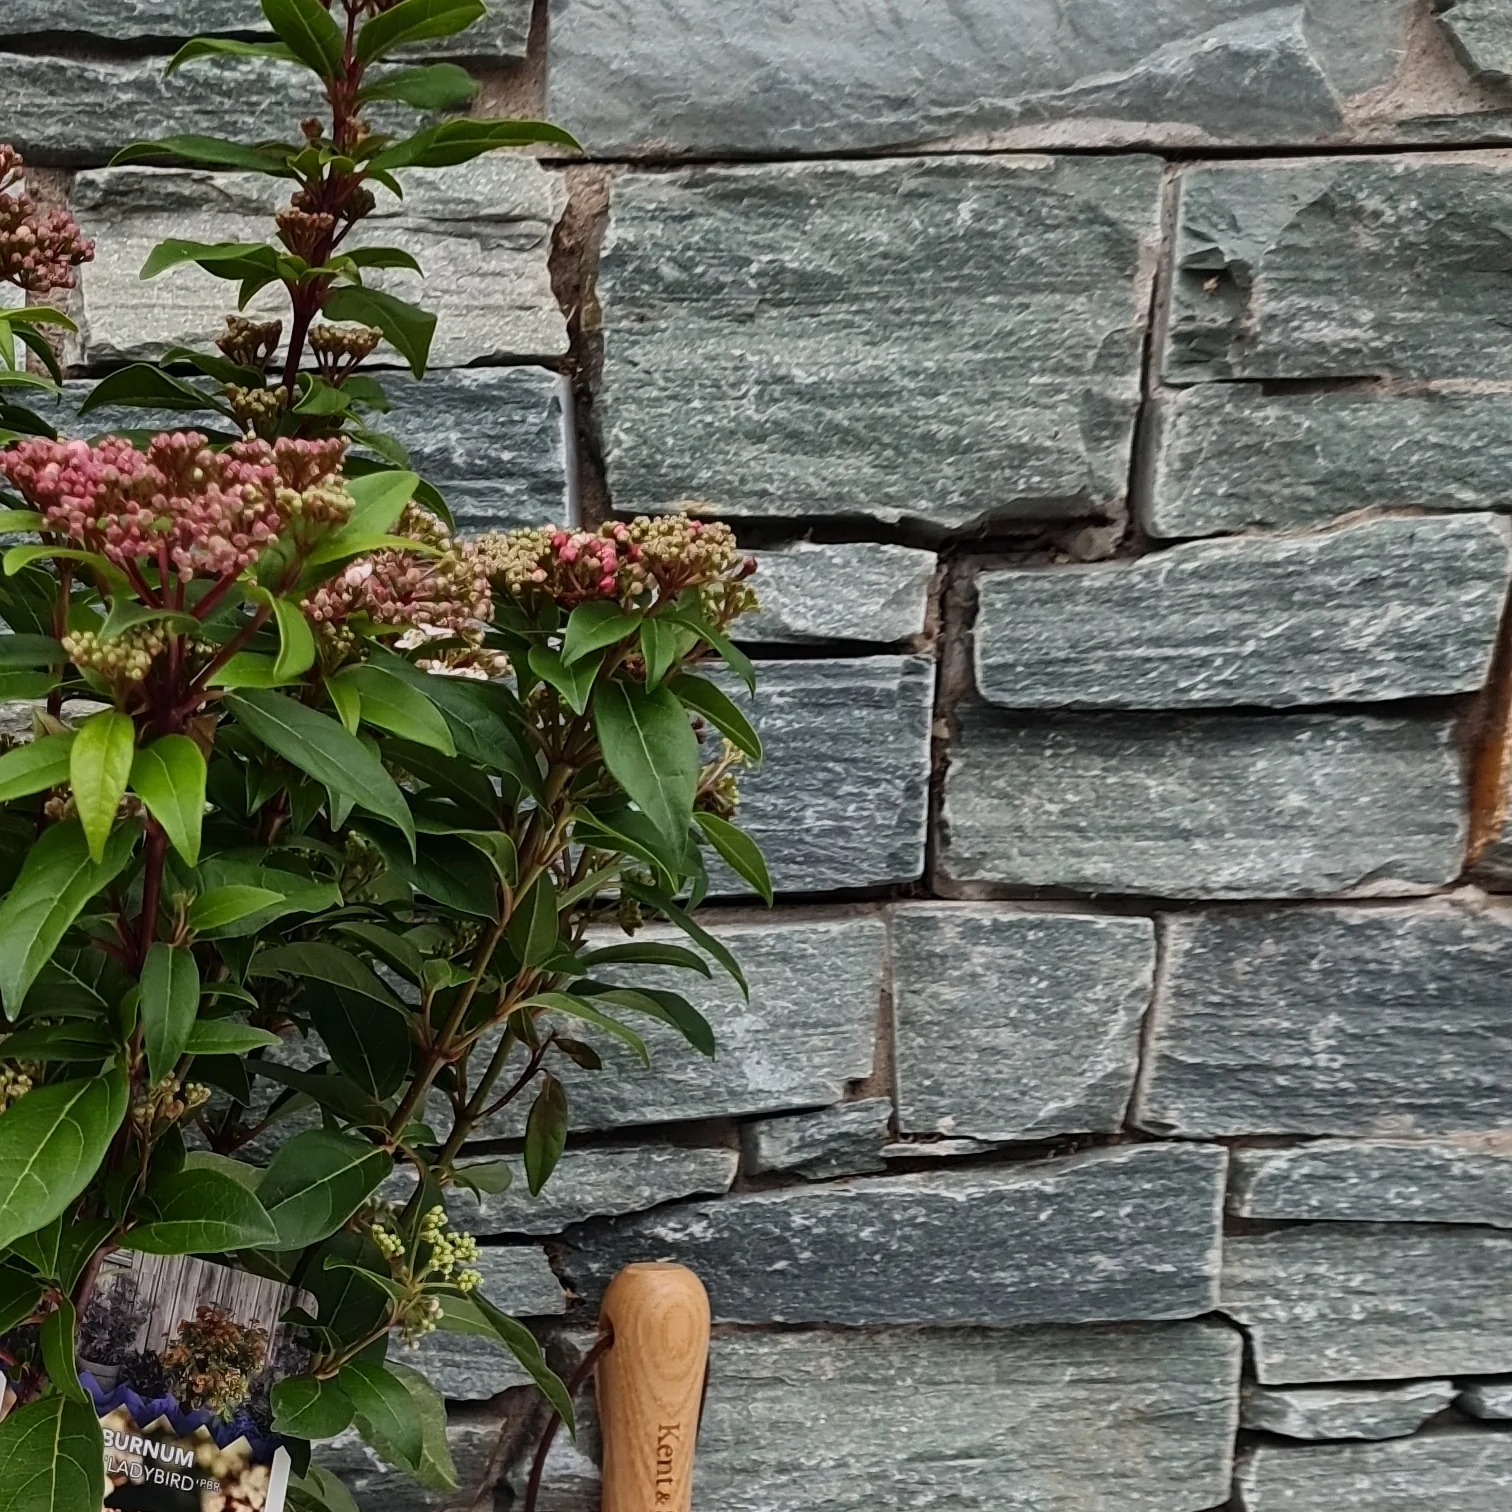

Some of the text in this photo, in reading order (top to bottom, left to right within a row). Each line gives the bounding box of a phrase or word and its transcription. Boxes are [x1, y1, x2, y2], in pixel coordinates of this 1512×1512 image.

[102, 1428, 195, 1468] BURNUM
[656, 1423, 681, 1486] Kent
[654, 1491, 671, 1505] &
